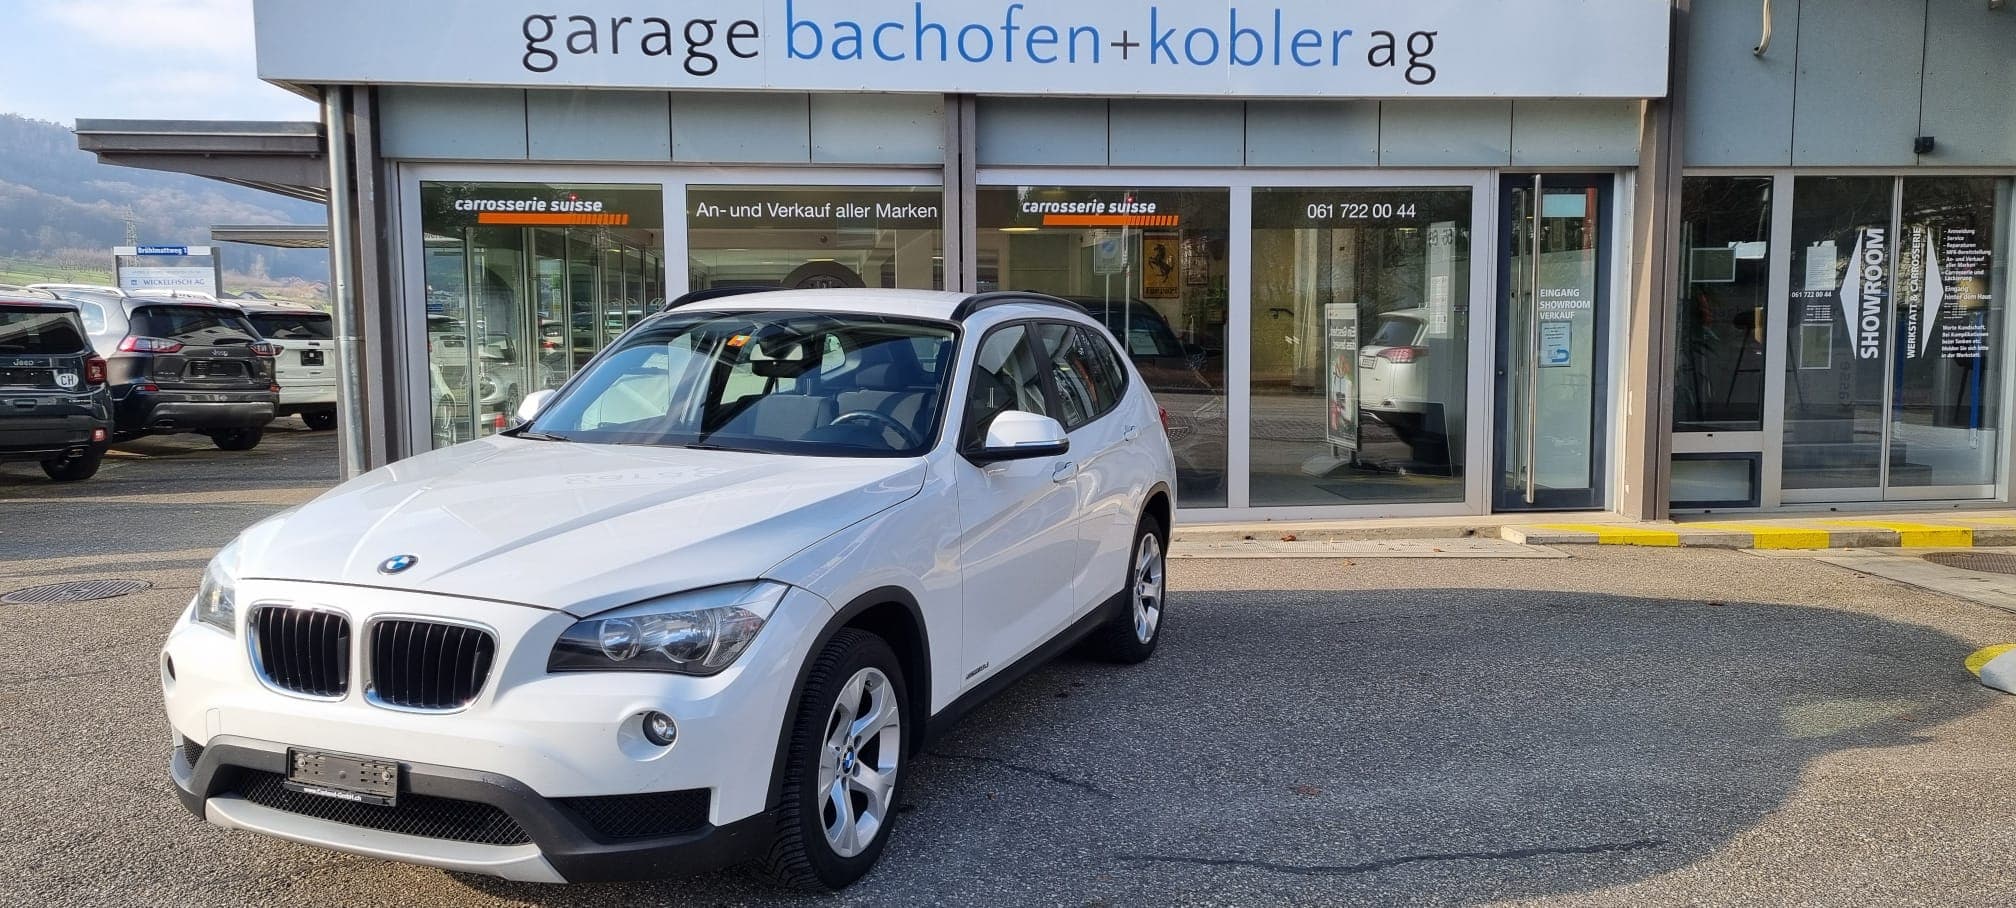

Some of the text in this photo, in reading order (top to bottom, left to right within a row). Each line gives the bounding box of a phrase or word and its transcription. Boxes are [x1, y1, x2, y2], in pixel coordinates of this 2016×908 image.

[522, 13, 760, 77] garage
[1367, 29, 1438, 85] ag
[454, 196, 603, 212] carrosserie suisse
[696, 201, 938, 218] An- und Verkauf aller Marken
[1022, 199, 1157, 213] carrosserie suisse
[1307, 203, 1416, 218] 061 722 00 44
[1540, 288, 1580, 297] EINGANG
[1860, 228, 1885, 359] SHOWROOM
[1906, 227, 1921, 359] WERKSTATT & CARROSSERIE
[1944, 285, 1969, 293] Eingang
[1539, 300, 1591, 309] SHOWROOM
[1540, 311, 1575, 320] VERKAUF
[12, 358, 34, 366] Jeep
[60, 375, 74, 386] CH
